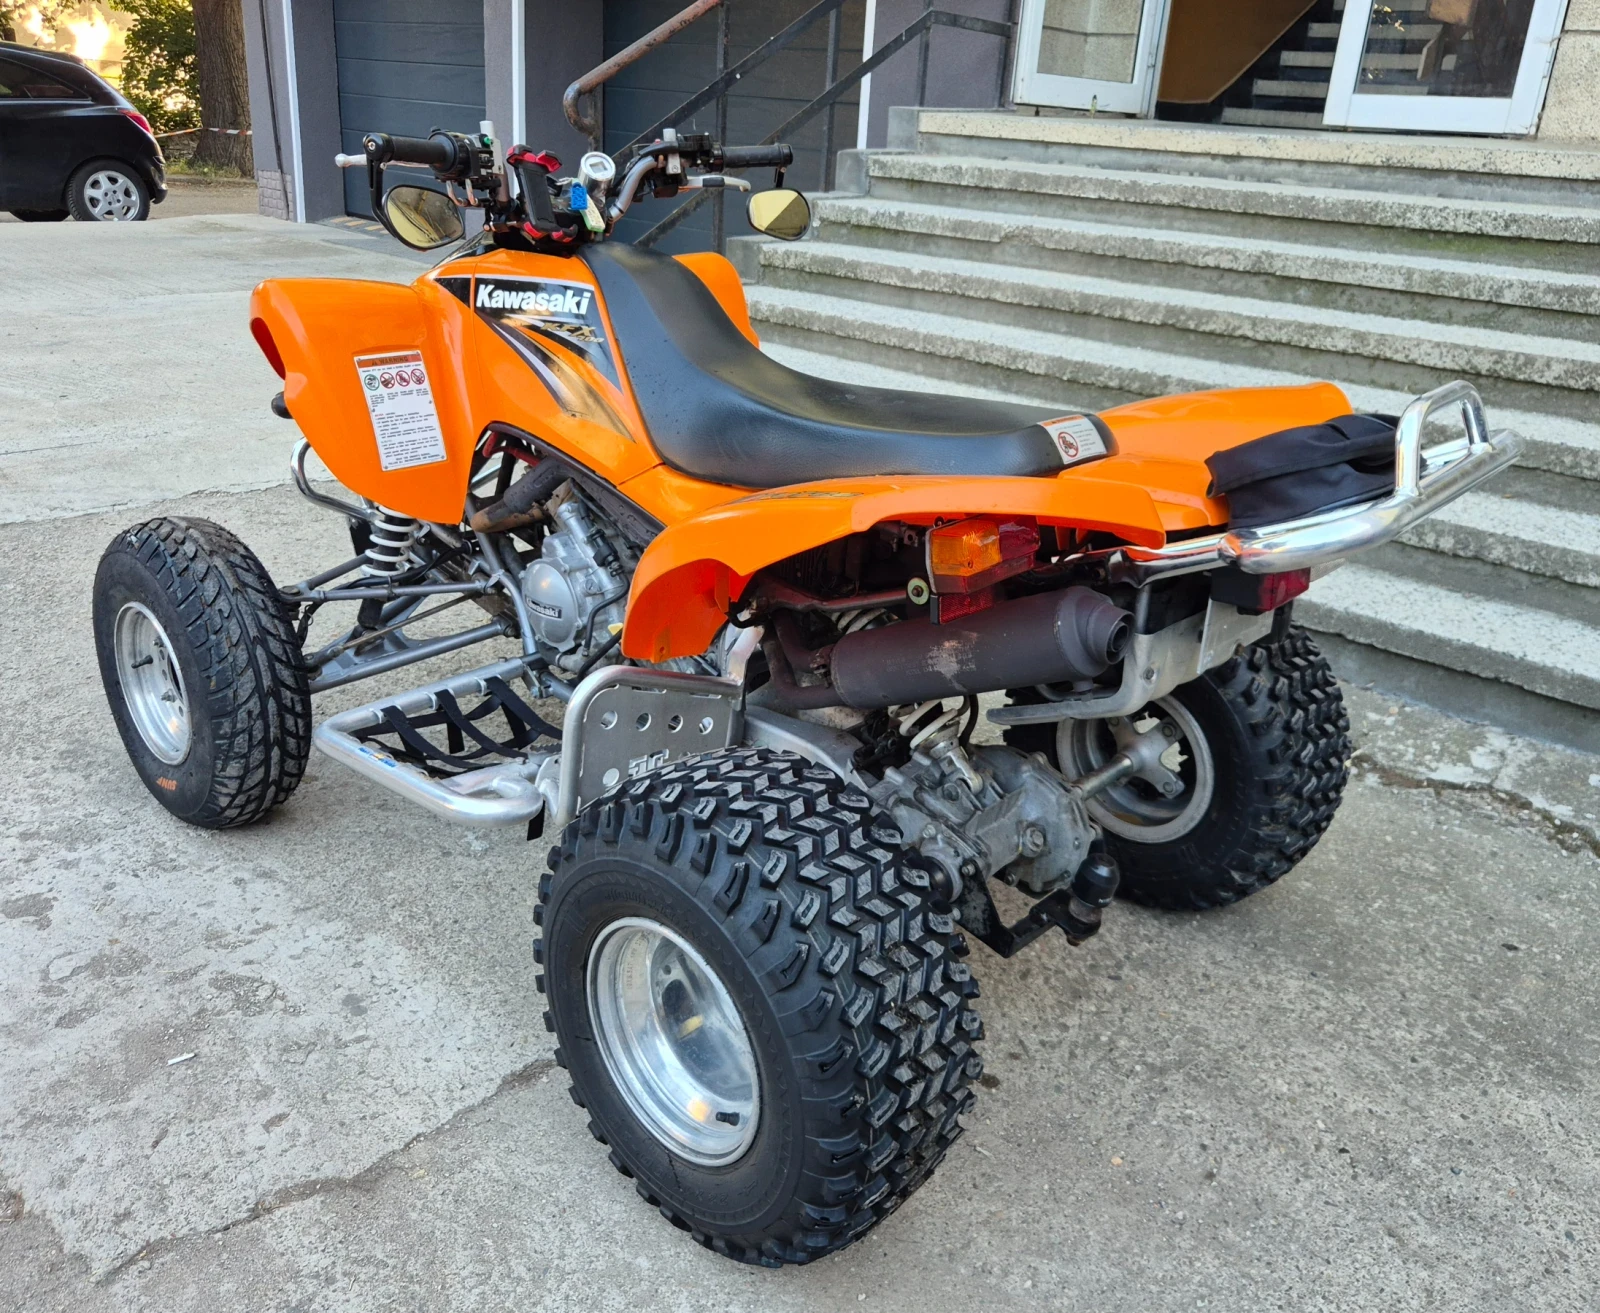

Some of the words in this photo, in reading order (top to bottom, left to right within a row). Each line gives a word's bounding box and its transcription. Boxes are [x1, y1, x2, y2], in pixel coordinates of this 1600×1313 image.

[476, 284, 591, 314] Kawasaki
[540, 322, 597, 337] KFX
[380, 356, 409, 365] WARNING
